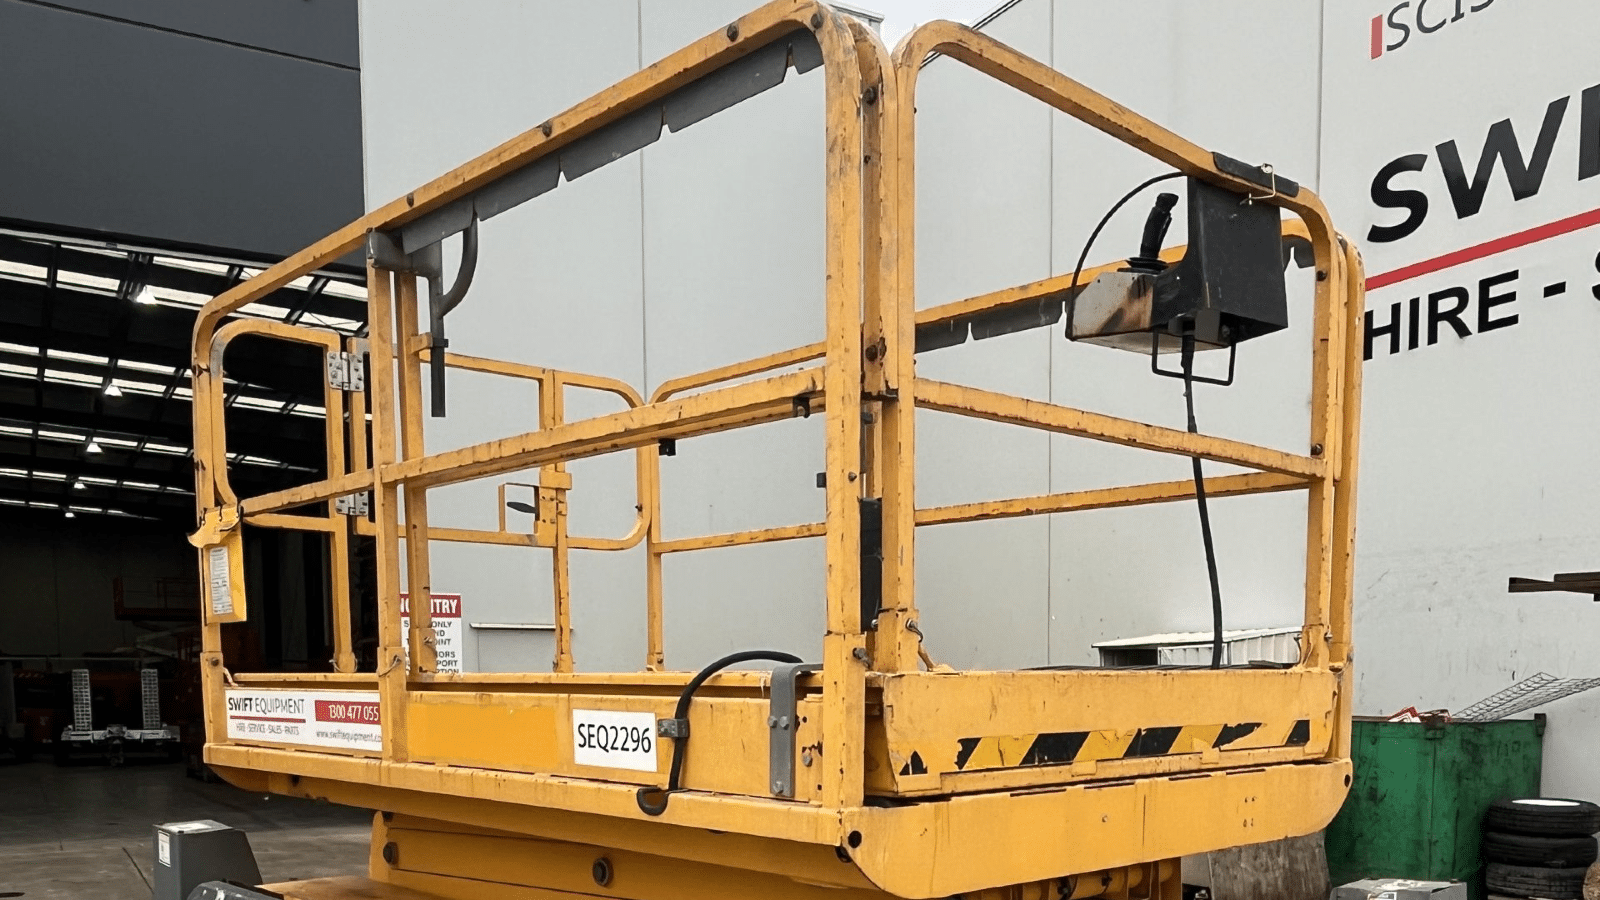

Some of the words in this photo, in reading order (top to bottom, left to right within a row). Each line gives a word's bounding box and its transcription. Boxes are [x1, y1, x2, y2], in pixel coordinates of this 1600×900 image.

[1386, 0, 1496, 52] SC
[1364, 269, 1519, 361] HIRE
[228, 697, 253, 712] SWIFT
[255, 697, 304, 714] EQUIPMENT
[347, 705, 362, 720] 477
[363, 706, 379, 722] 055
[577, 723, 651, 753] SEQ2296
